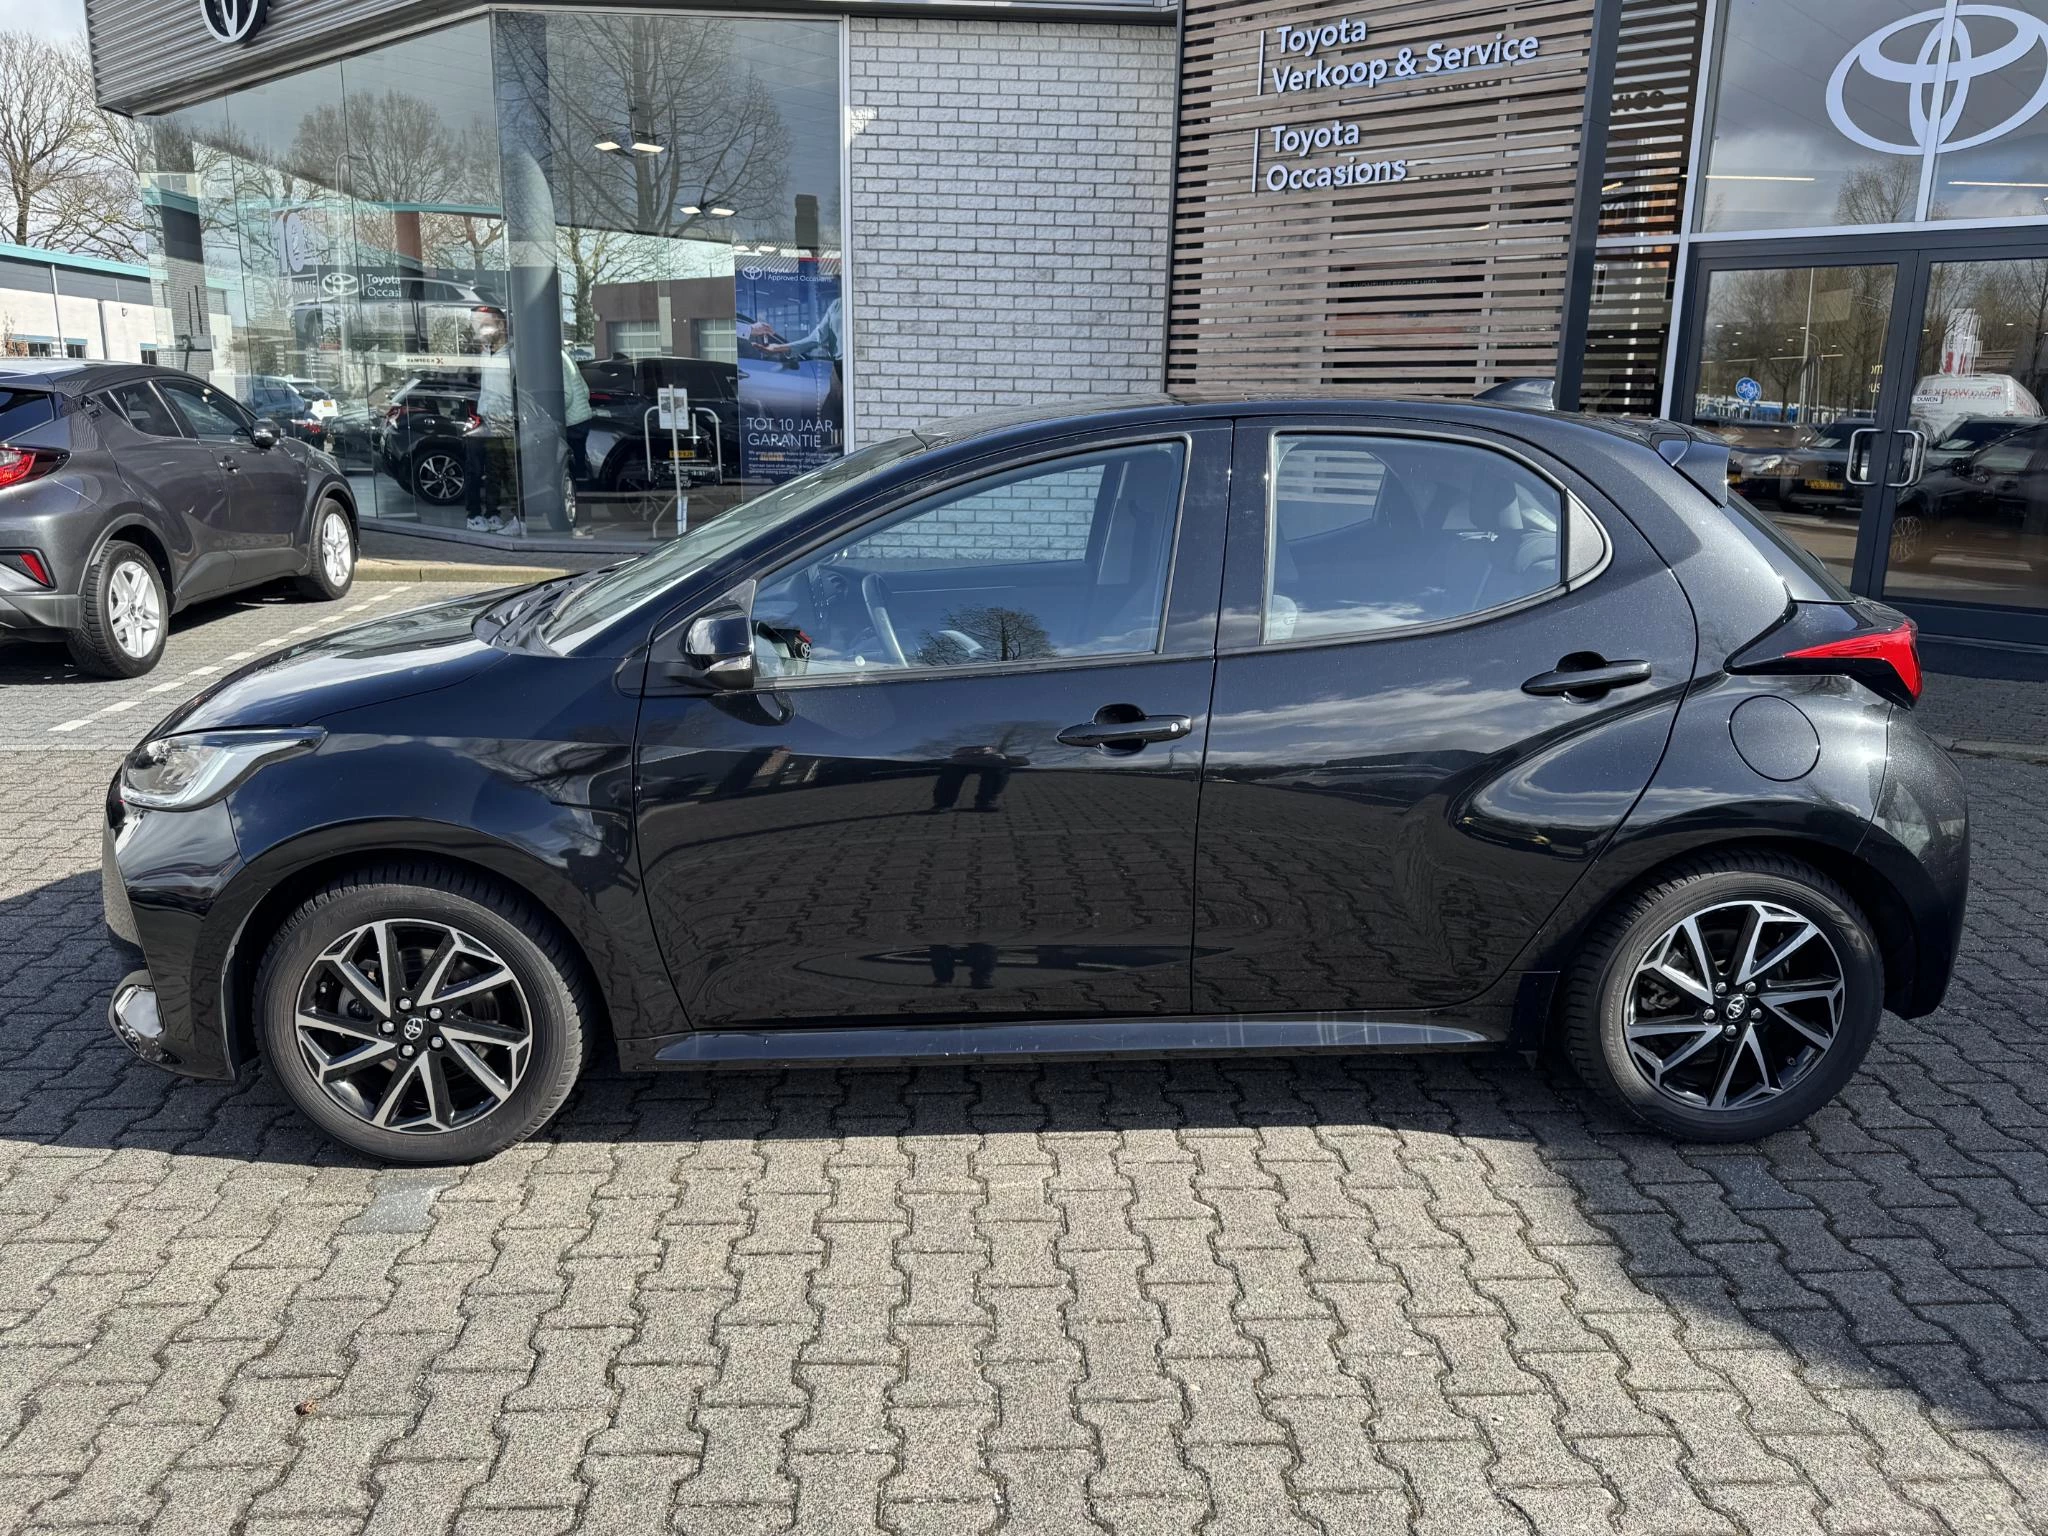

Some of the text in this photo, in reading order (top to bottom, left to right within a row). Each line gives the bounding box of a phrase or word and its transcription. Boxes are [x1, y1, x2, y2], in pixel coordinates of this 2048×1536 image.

[1276, 17, 1367, 58] Toyota
[1272, 32, 1540, 94] Verkoop & Service
[1271, 119, 1360, 157] Toyota
[1266, 157, 1408, 193] Occasions
[366, 273, 400, 287] Toyota
[767, 274, 799, 282] Approved
[746, 416, 834, 433] TOT 10 JAAR
[747, 432, 822, 448] GARANTIE
